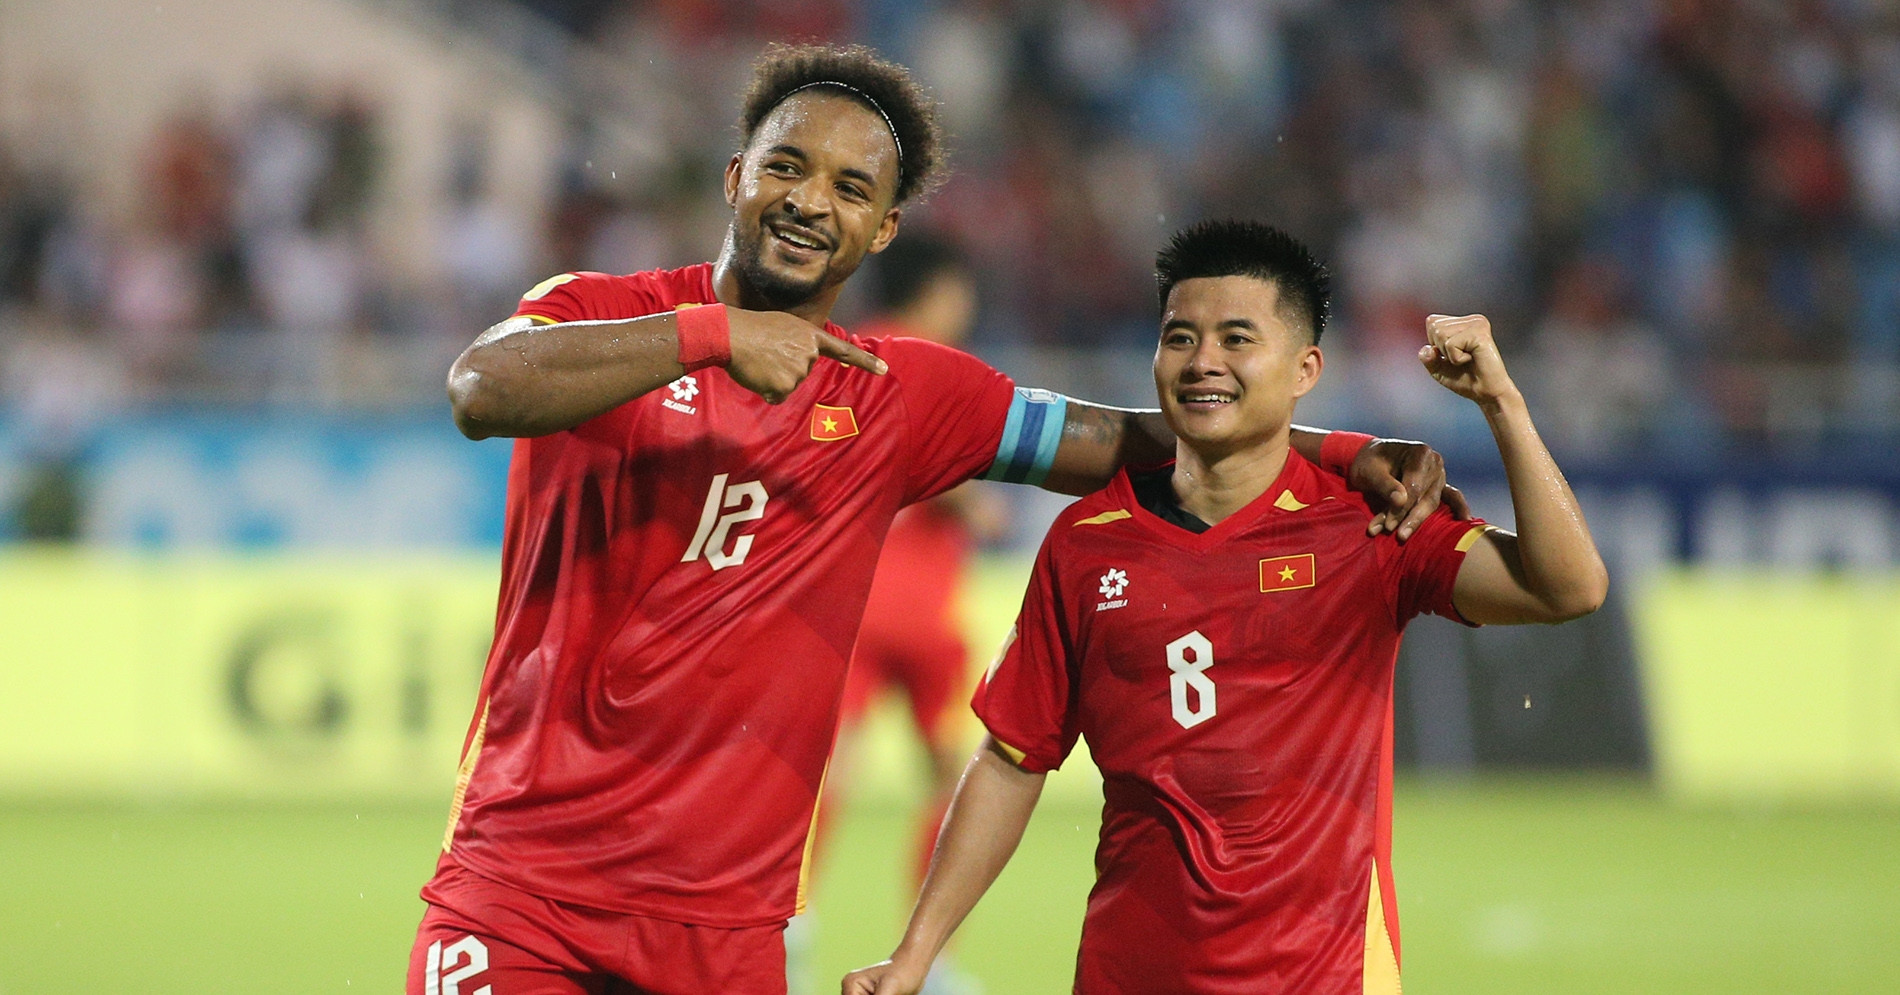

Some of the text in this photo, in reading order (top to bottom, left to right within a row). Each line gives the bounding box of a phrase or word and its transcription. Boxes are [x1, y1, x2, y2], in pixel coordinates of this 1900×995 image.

[680, 473, 770, 571] 12
[1165, 629, 1218, 730] 8
[425, 934, 493, 995] 12
